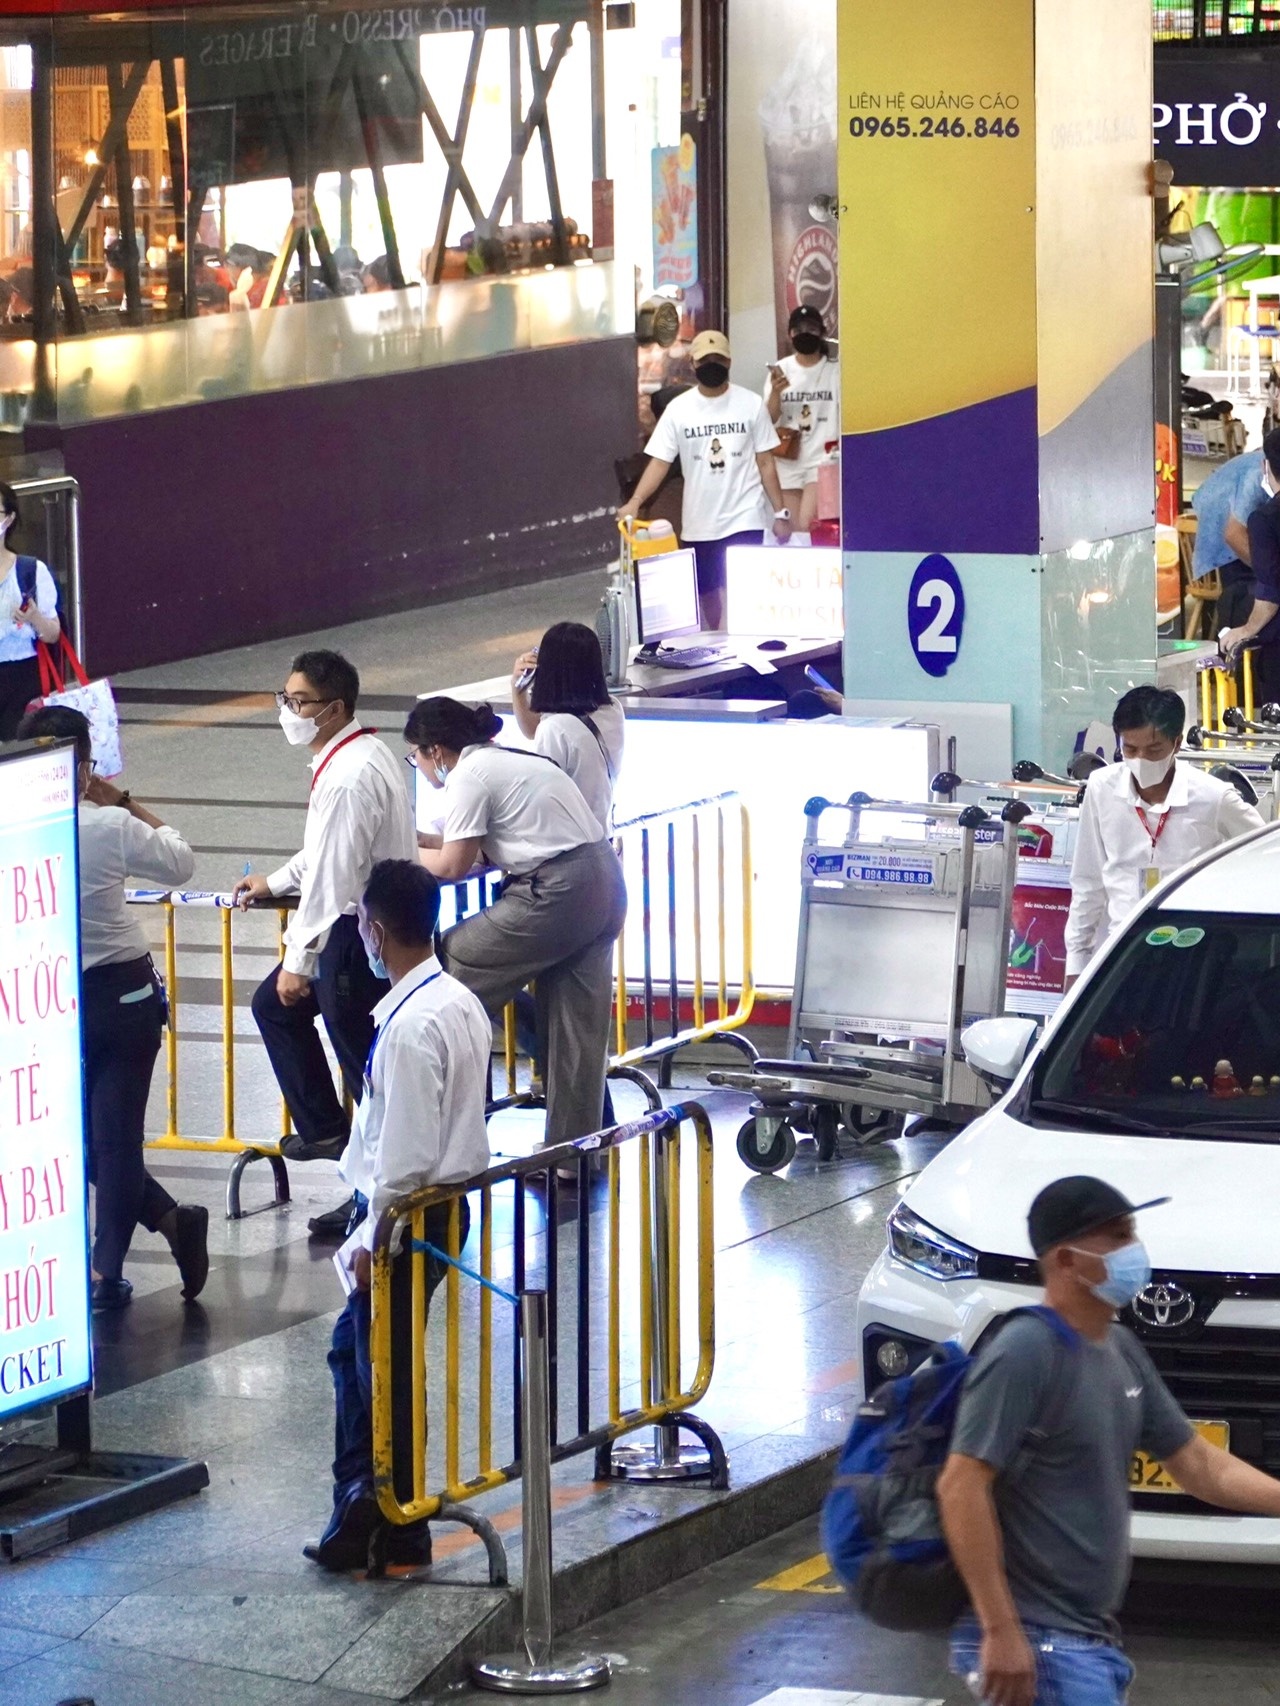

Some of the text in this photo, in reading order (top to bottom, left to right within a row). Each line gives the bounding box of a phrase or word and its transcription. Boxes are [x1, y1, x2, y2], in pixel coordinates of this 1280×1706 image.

[849, 90, 1019, 112] LIÊN HỆ QUẢNG CÁO
[849, 116, 1020, 138] 0965.246.846
[1153, 92, 1268, 146] PHỞ
[684, 422, 747, 439] CALIFORNIA
[916, 578, 957, 653] 2
[12, 854, 62, 924] BAY
[864, 868, 929, 883] 094.986.98.98
[21, 1154, 70, 1226] BAY
[3, 1245, 58, 1331] HÓT
[0, 1338, 67, 1395] CKET
